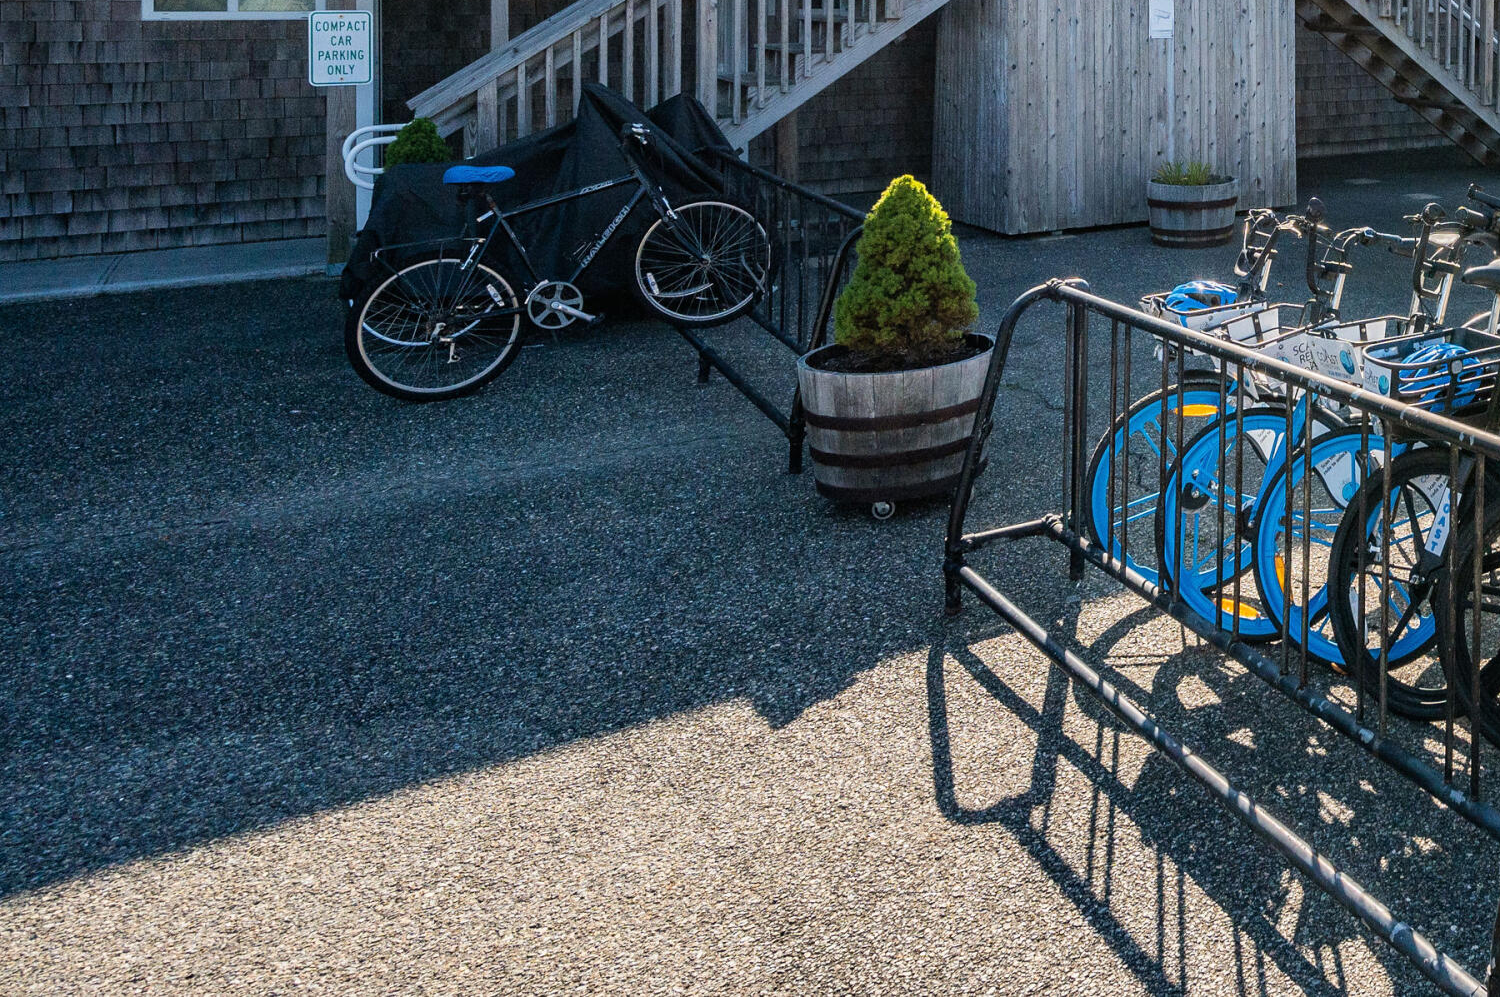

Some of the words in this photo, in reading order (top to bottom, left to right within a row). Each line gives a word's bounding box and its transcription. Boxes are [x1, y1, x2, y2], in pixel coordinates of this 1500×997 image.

[315, 20, 367, 32] COMPACT
[330, 35, 352, 46] CAR
[318, 49, 365, 61] PARKING
[327, 64, 355, 76] ONLY
[1430, 493, 1451, 552] OAST
